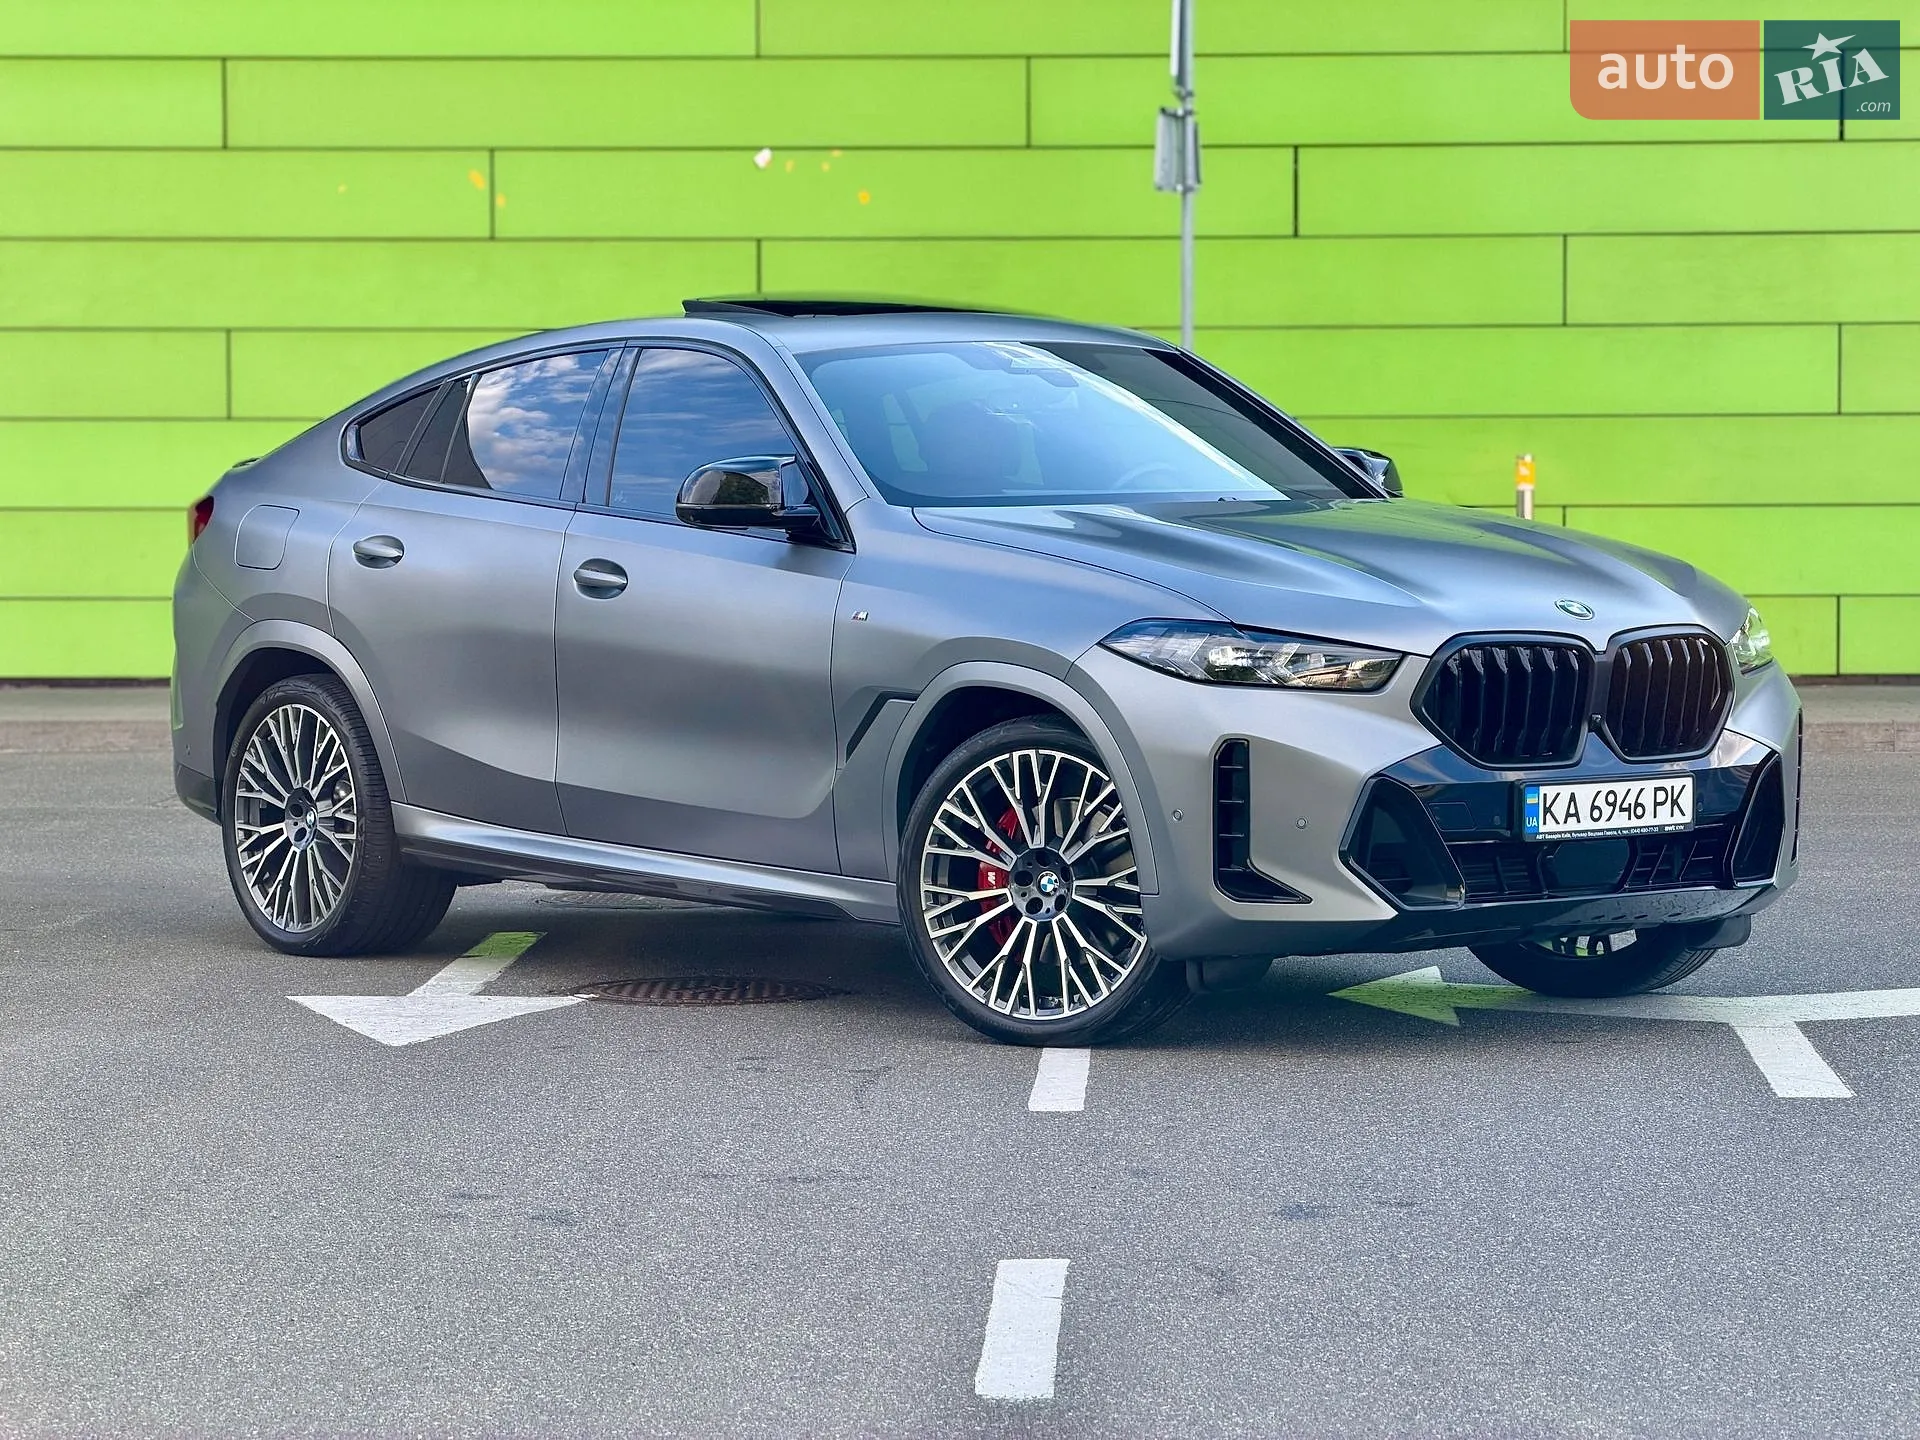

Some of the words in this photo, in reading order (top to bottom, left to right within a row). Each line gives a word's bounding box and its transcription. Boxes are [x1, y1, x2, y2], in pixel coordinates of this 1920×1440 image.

[1542, 791, 1581, 826] KA
[1589, 787, 1646, 823] 6946
[1653, 784, 1687, 819] PK
[1525, 816, 1538, 828] UA
